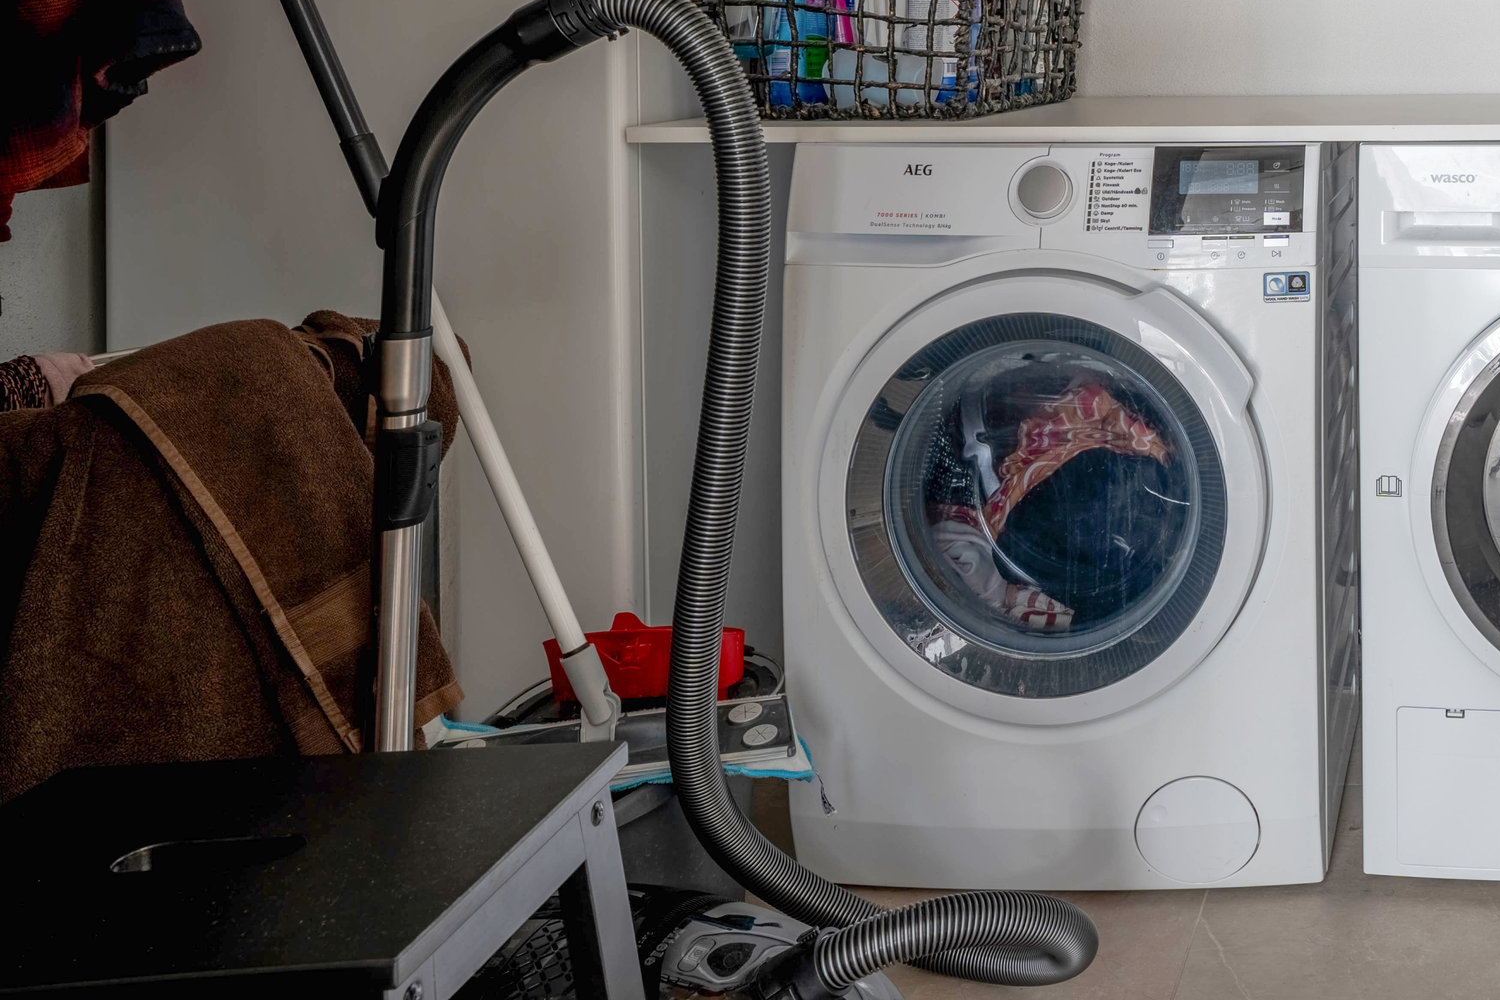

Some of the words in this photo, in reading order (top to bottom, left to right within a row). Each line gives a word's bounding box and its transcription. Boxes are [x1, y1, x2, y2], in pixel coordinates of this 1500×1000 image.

[903, 163, 933, 176] AEG
[1430, 174, 1475, 183] wasco
[902, 222, 935, 230] Technology
